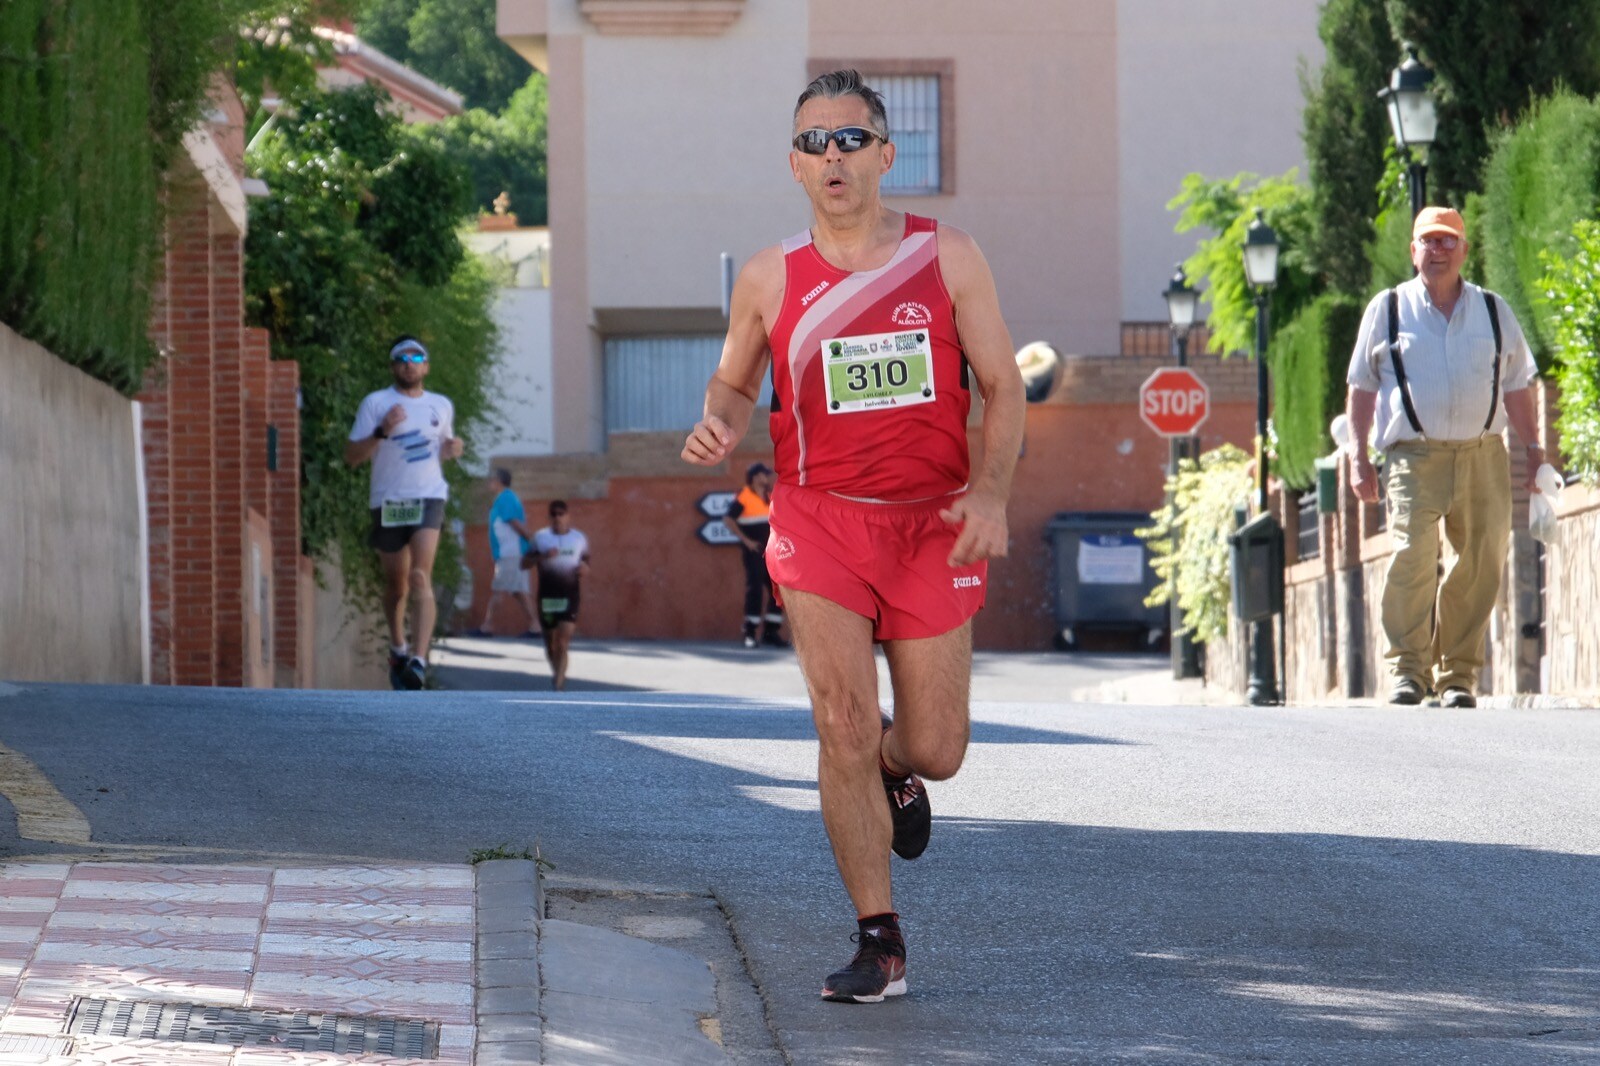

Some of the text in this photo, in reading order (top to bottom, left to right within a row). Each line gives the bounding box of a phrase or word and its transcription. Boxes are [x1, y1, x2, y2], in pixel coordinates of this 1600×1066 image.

[891, 306, 901, 322] CLUB
[847, 359, 909, 391] 310
[864, 399, 890, 408] helvetia
[1145, 389, 1204, 416] STOP
